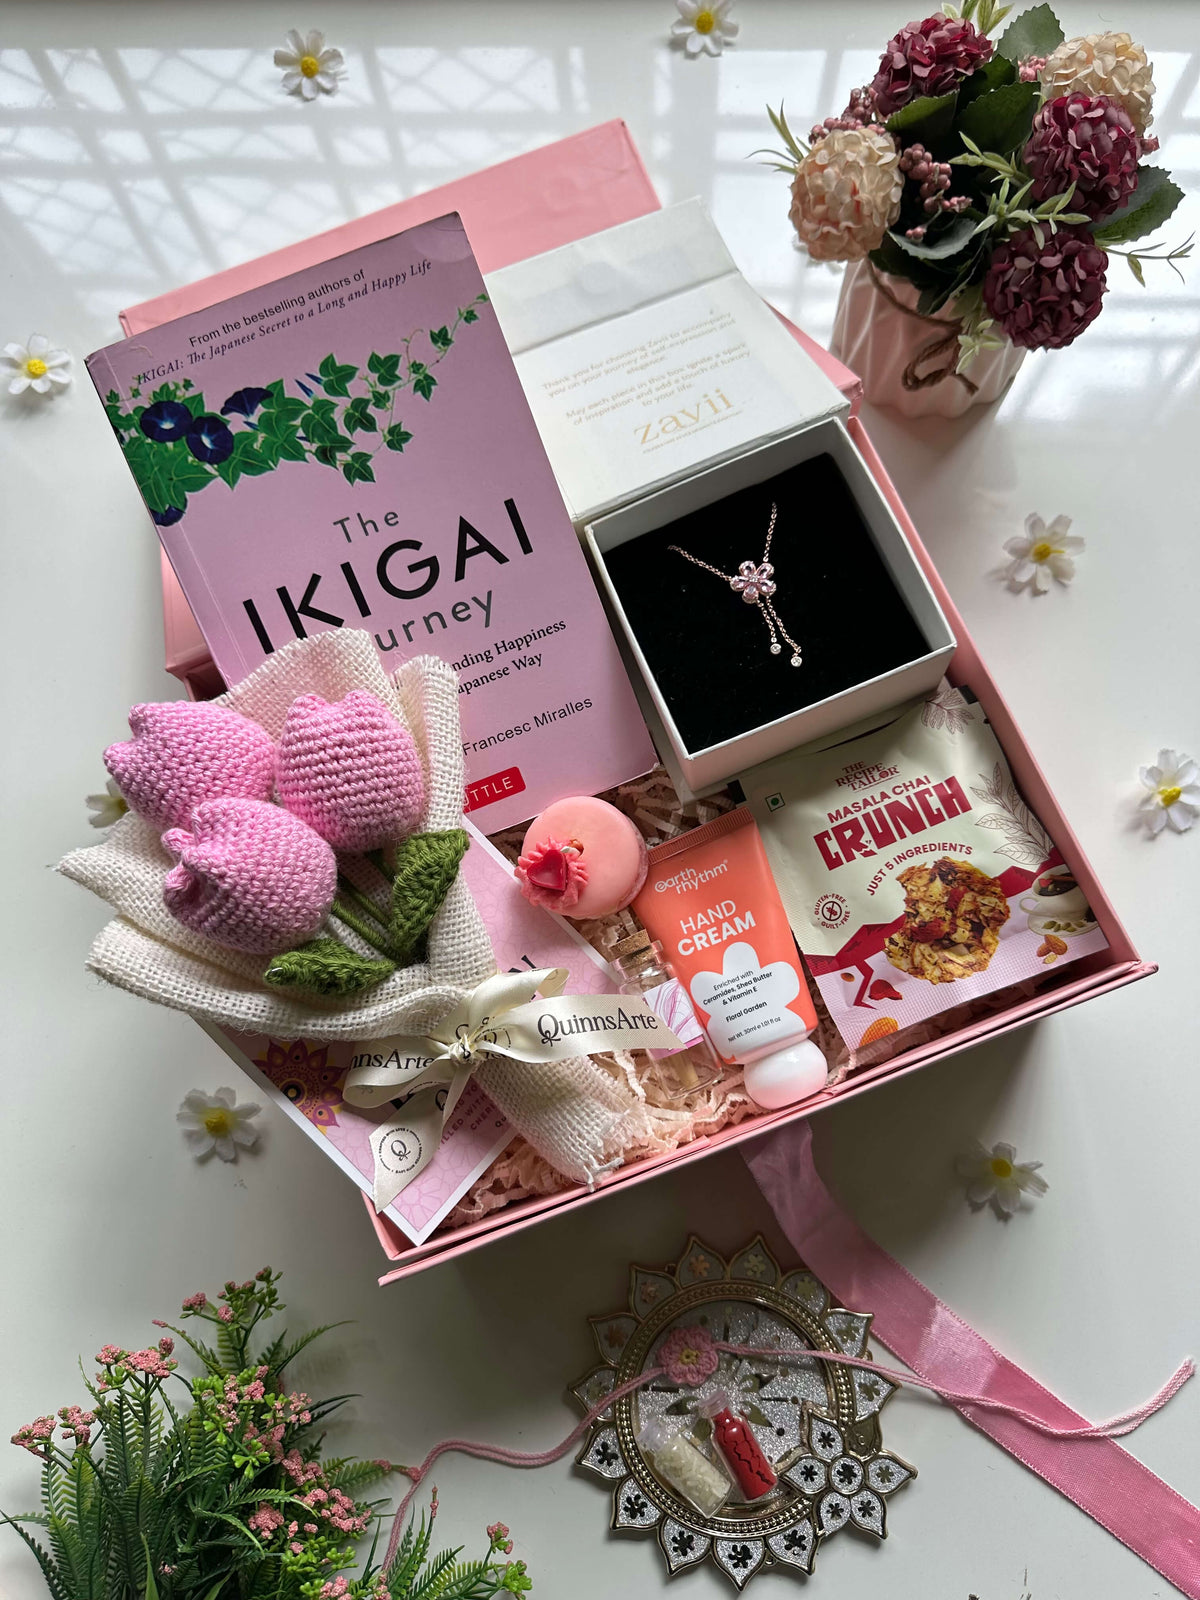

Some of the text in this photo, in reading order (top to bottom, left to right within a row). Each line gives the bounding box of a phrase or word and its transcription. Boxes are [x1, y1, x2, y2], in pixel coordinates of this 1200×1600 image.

[137, 259, 432, 386] IKIGAI: The Japanese Secret to a Long and Happy Life
[189, 268, 366, 347] From the bestselling authors of
[634, 388, 733, 445] zavii
[333, 511, 400, 543] The
[242, 498, 534, 655] IKIGAI
[374, 590, 492, 652] urney
[452, 620, 567, 671] nding Happiness
[458, 653, 543, 695] apanese Way
[462, 698, 593, 755] Francesc Miralles
[835, 763, 885, 787] RECIPE
[842, 761, 864, 774] THE
[827, 775, 931, 823] MASALA CHAI
[813, 775, 973, 871] CRUNCH
[654, 868, 697, 893] earth
[866, 842, 973, 896] JUST 5 INGREDIENTS
[677, 910, 756, 956] CREAM
[680, 900, 736, 934] HAND
[703, 972, 773, 1005] Ceramides, Shea Butter
[713, 970, 754, 991] Enriched with
[728, 989, 753, 1002] Vitamin
[537, 1007, 658, 1047] QuinnsArte
[726, 1001, 768, 1023] Floral Garden
[351, 1048, 435, 1069] nnsArte
[390, 1139, 411, 1161] Q
[440, 1119, 464, 1145] ILLED
